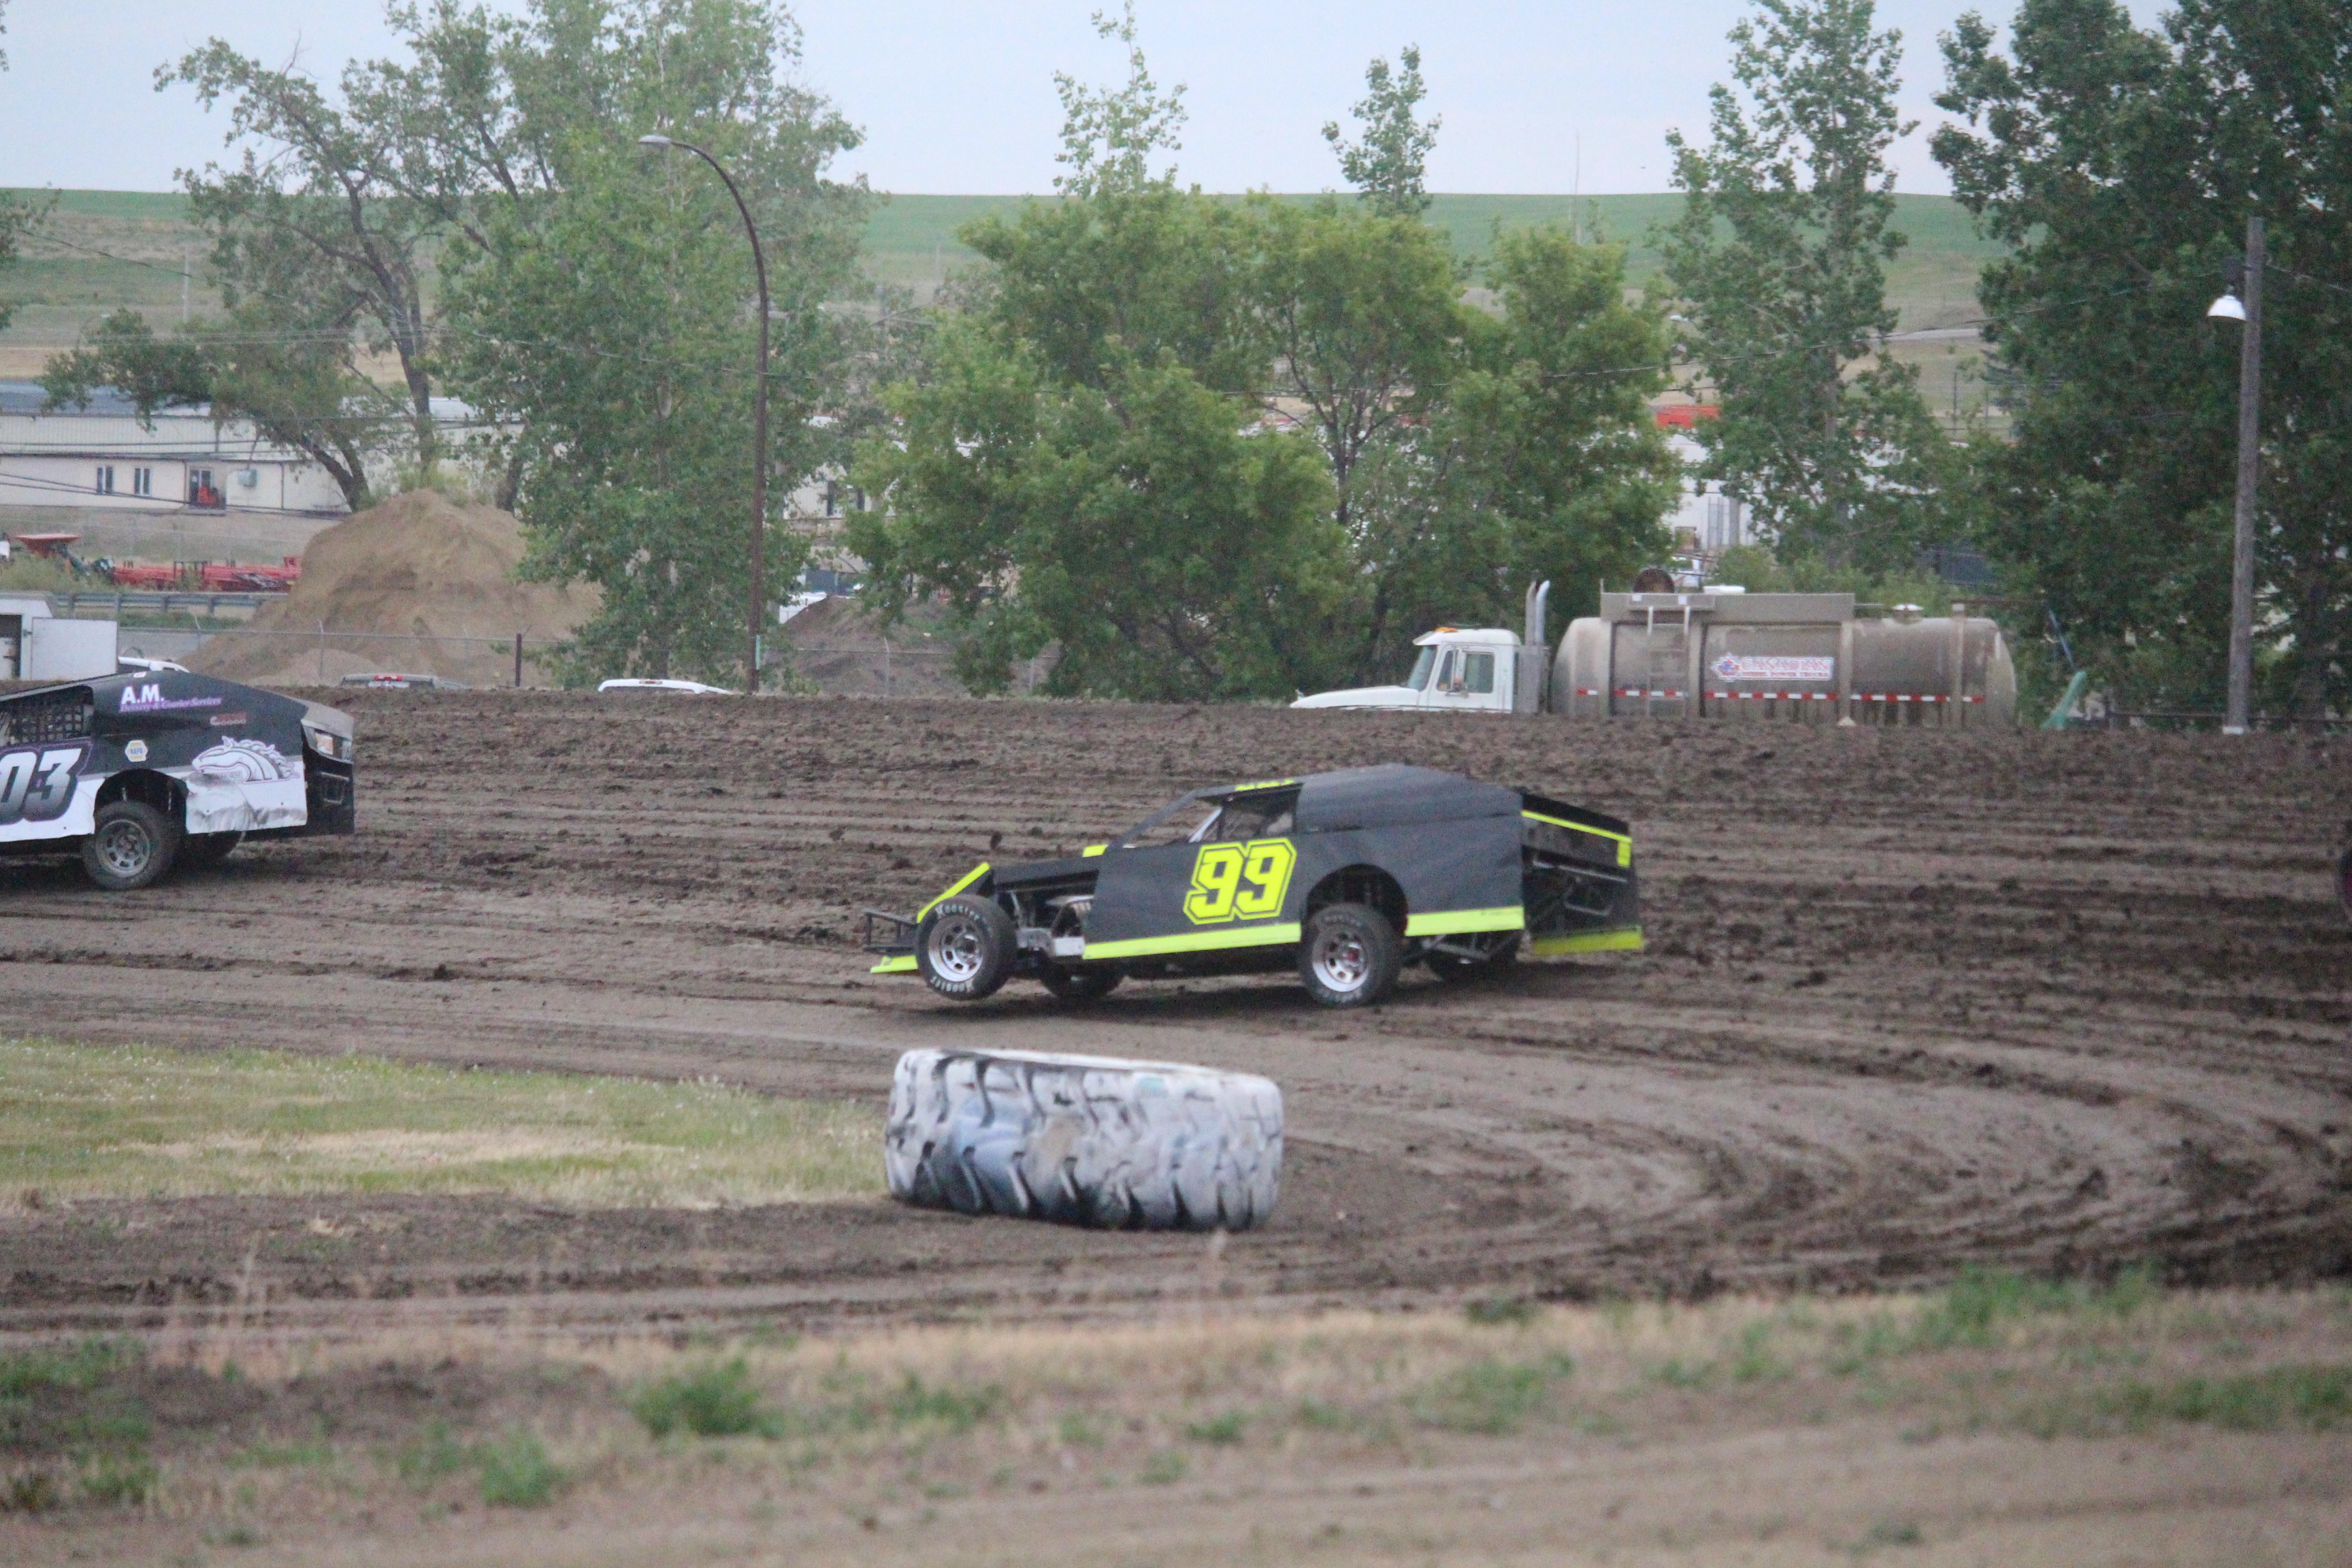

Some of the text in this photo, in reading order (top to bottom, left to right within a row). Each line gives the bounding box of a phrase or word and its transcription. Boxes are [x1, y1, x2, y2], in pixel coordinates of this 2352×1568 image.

[1741, 658, 1831, 671] CANADIAN
[121, 683, 165, 705] A.M.
[120, 703, 150, 713] Delivery
[161, 700, 189, 709] Courier
[191, 698, 222, 707] Services
[0, 748, 82, 823] 03
[1183, 837, 1298, 925] 99
